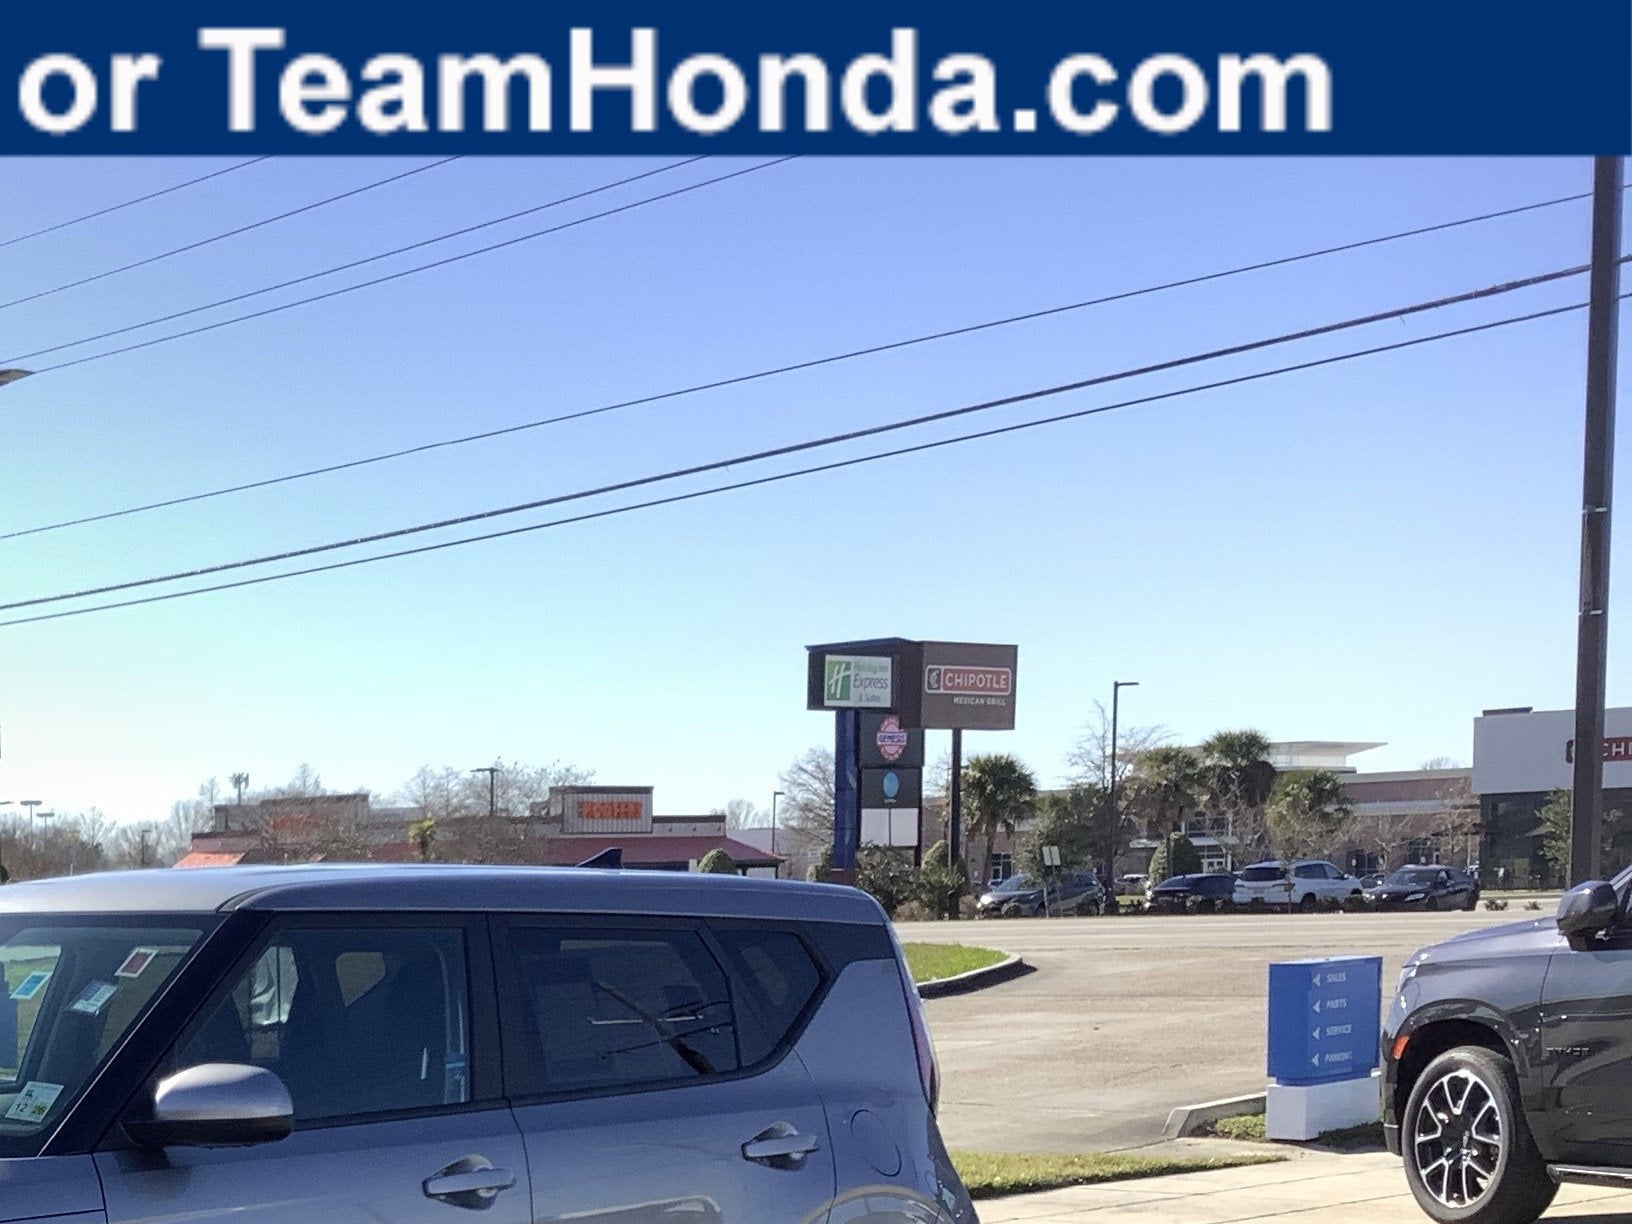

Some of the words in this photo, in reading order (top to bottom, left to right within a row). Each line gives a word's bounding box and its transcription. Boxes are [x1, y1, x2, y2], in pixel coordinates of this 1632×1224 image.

[853, 673, 888, 690] Express
[944, 672, 1008, 689] CHIPOTLE
[953, 696, 985, 705] MEXICAN
[1326, 998, 1347, 1010] PARTS
[1325, 1024, 1353, 1036] SERVICE
[16, 1102, 28, 1113] 12
